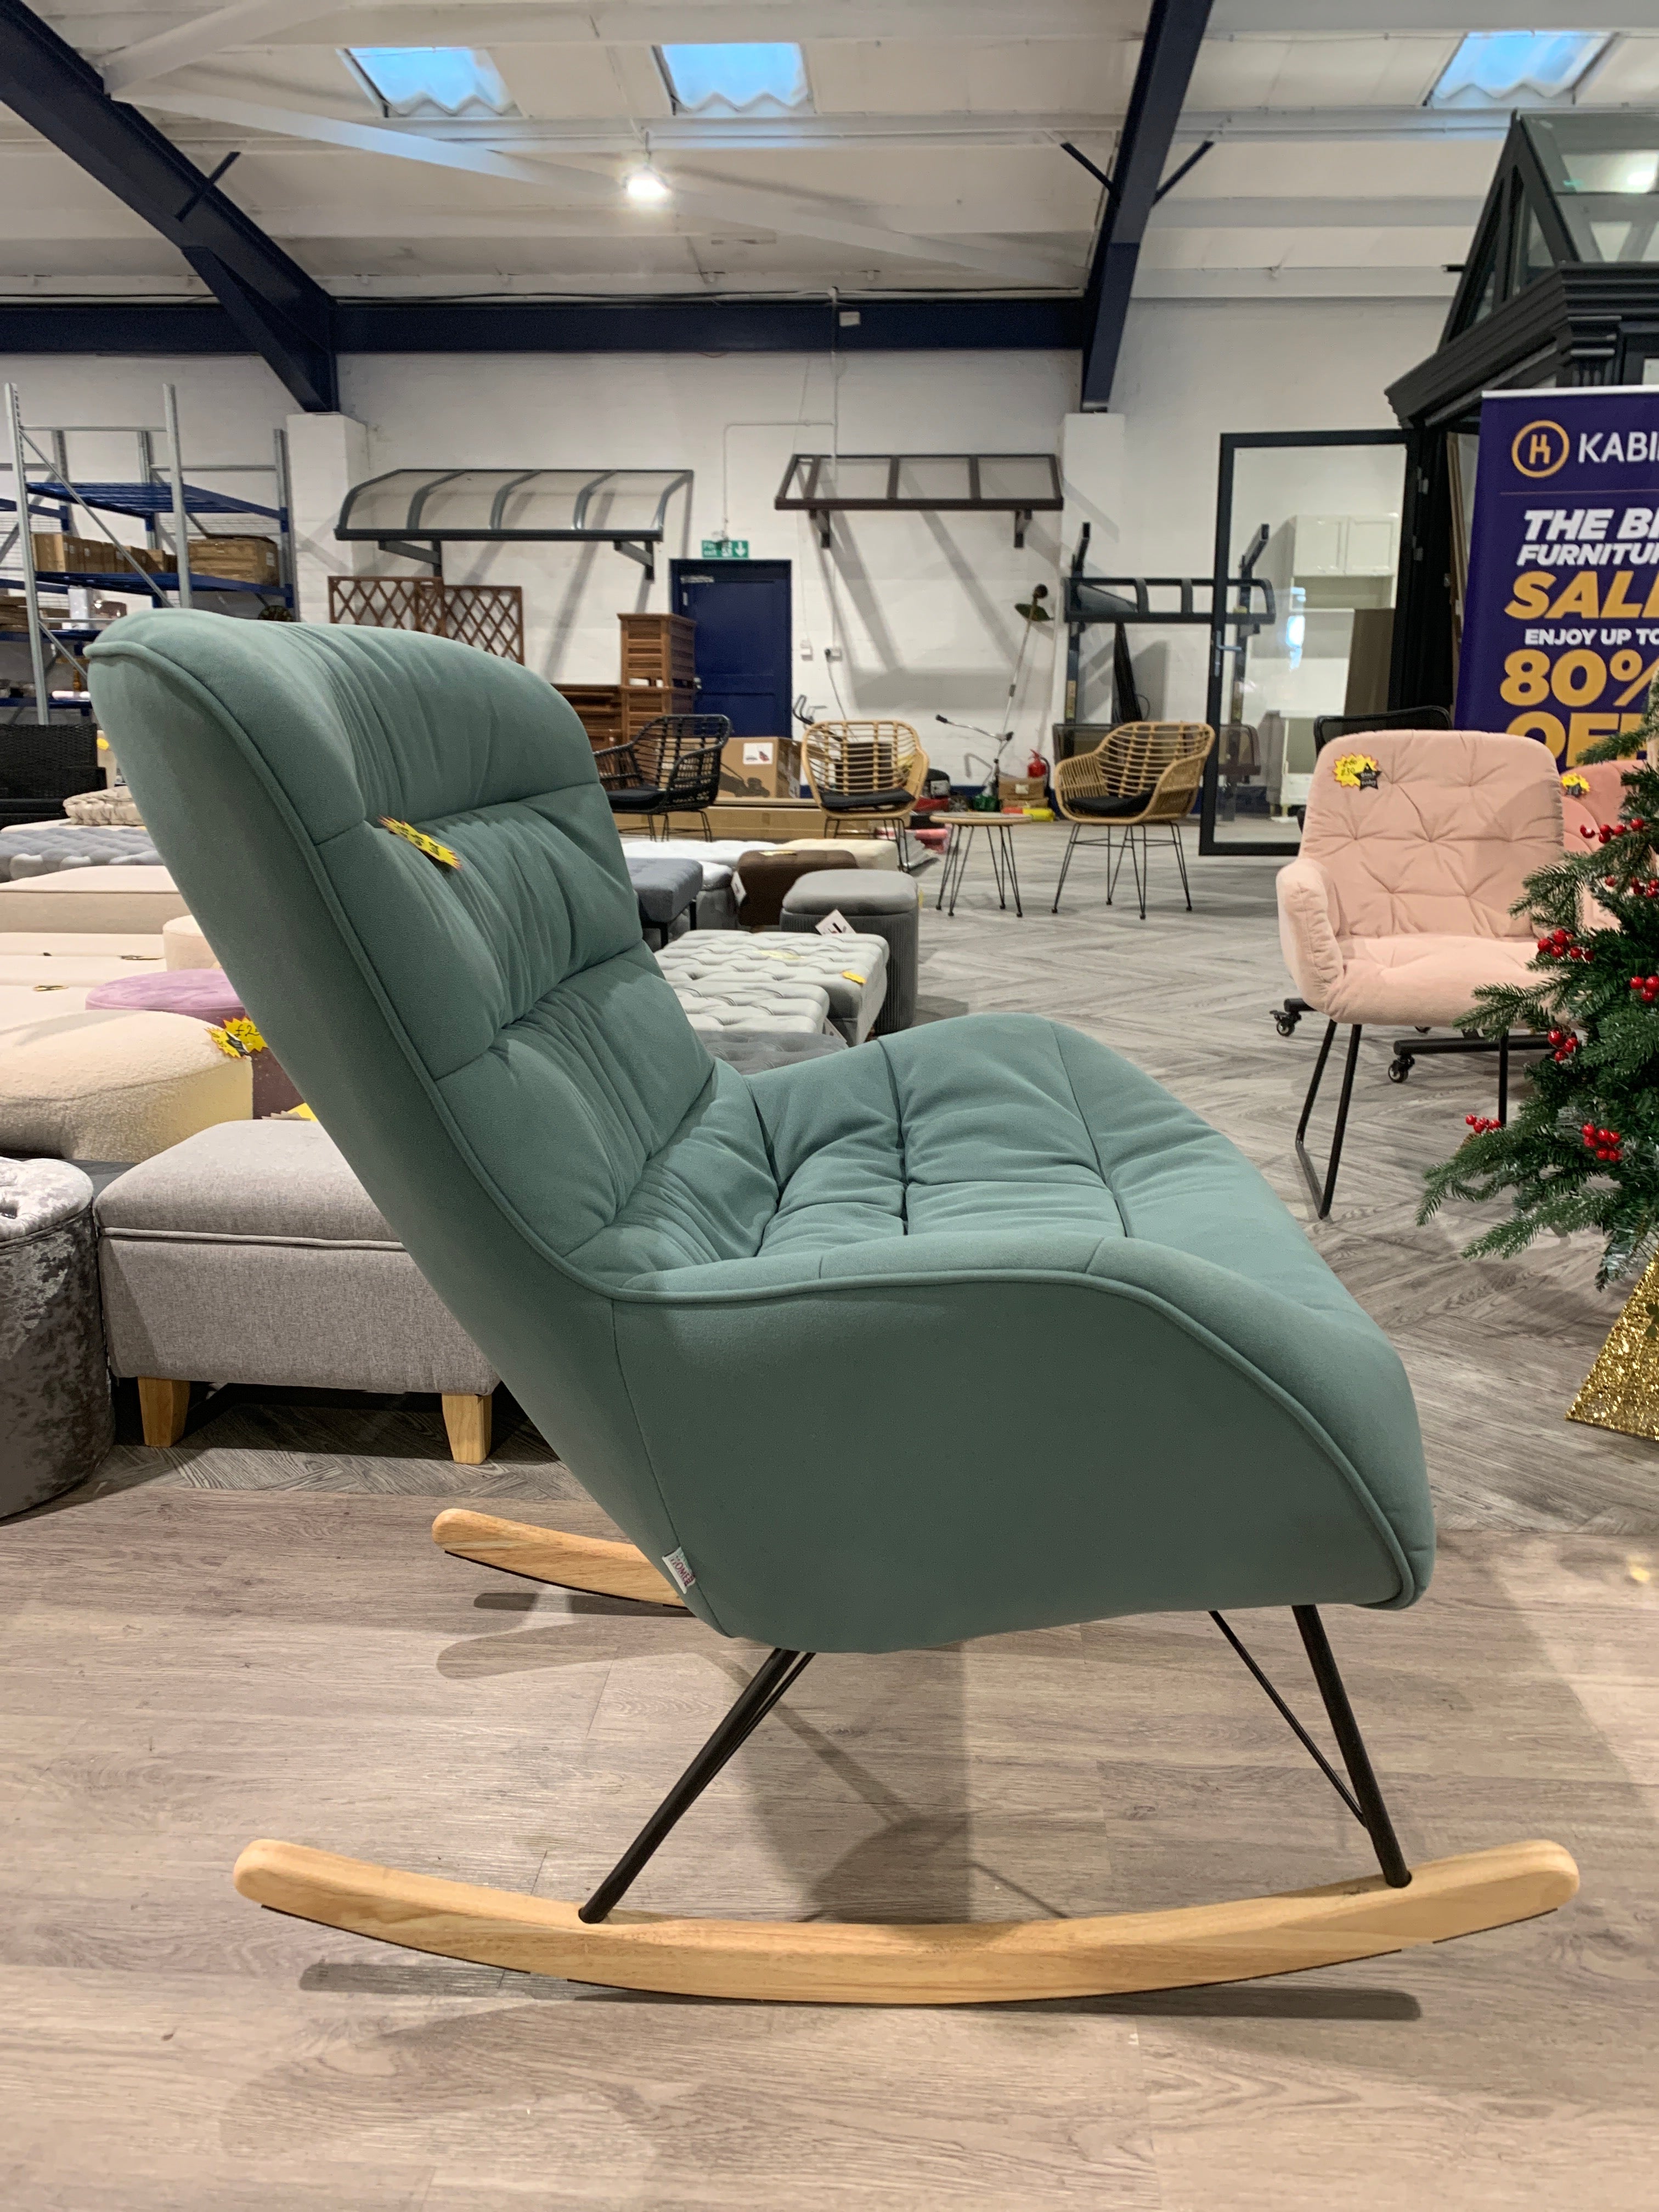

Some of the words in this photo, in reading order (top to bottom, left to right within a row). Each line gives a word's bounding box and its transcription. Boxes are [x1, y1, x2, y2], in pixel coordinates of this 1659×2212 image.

[1578, 431, 1659, 463] KABI
[1524, 509, 1614, 540] THE
[1525, 629, 1596, 645] ENJOY
[1600, 628, 1632, 645] UP
